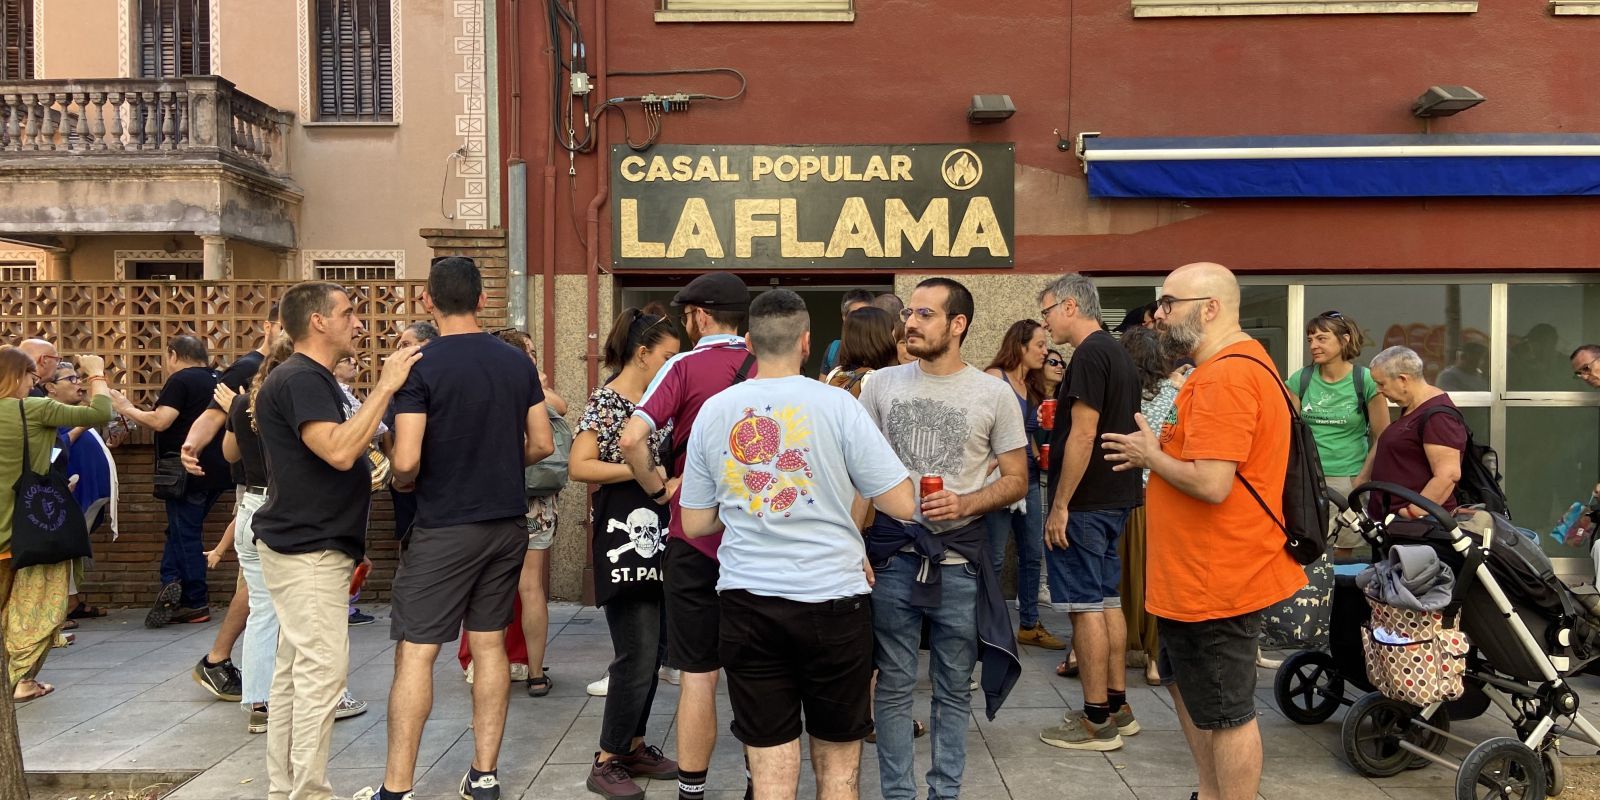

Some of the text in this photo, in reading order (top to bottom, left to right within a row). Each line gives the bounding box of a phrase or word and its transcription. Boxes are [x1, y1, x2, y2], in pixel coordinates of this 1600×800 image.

[620, 154, 914, 182] CASAL POPULAR
[620, 196, 1010, 259] LA FLAMA
[611, 567, 633, 583] ST.
